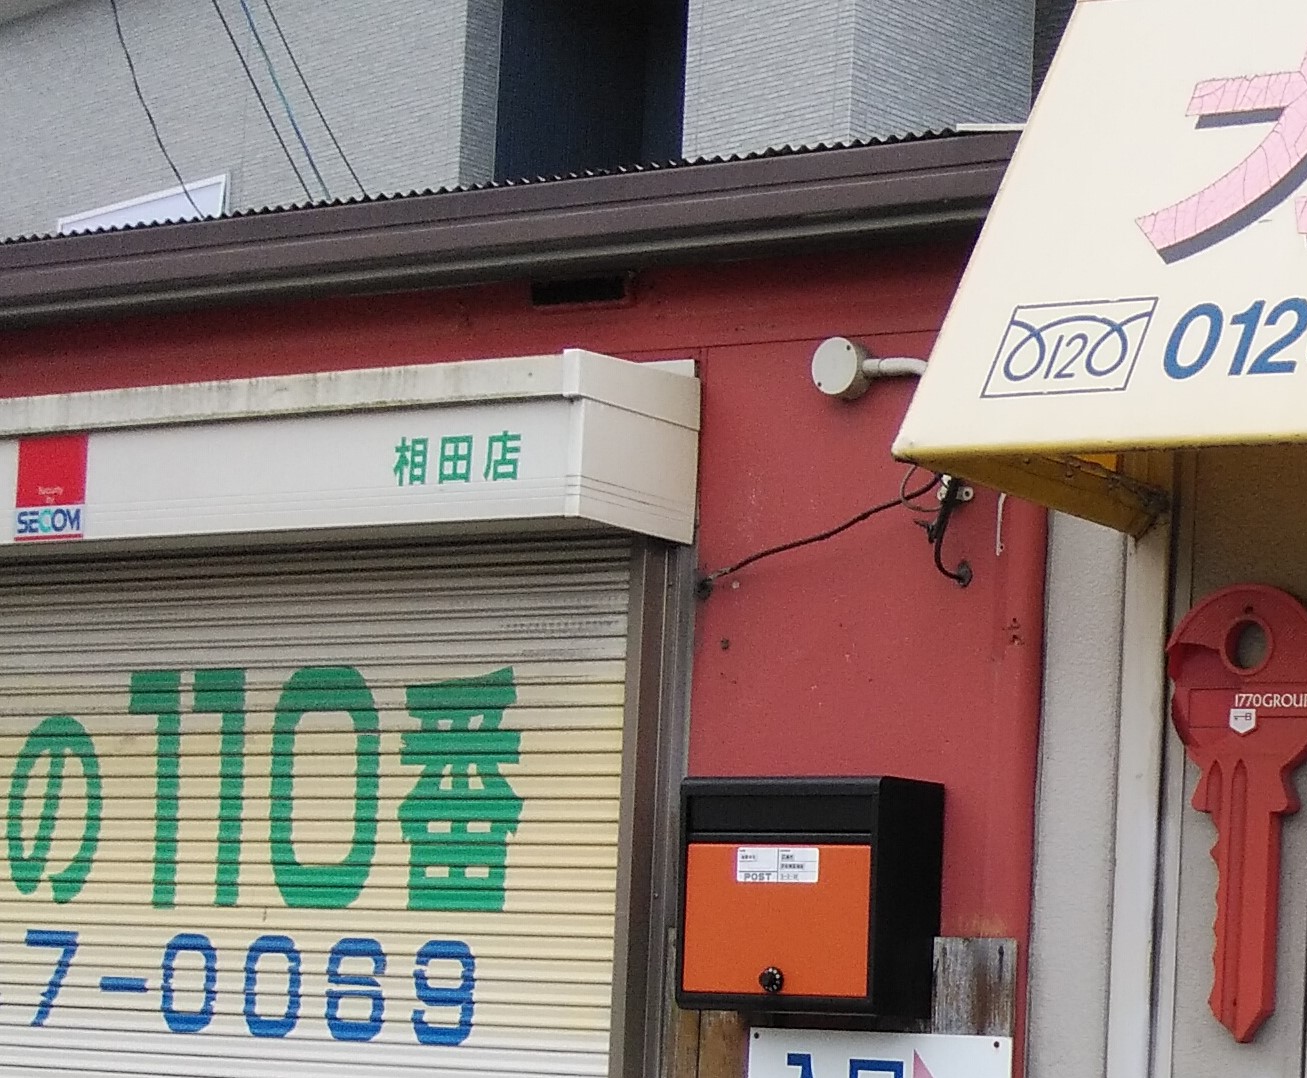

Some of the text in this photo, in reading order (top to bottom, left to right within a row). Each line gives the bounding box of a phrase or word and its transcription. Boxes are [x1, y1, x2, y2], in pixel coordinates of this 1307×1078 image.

[392, 430, 522, 486] 相田店
[17, 508, 81, 534] SECOM
[6, 666, 524, 911] の110番
[743, 872, 772, 882] POST
[25, 929, 476, 1046] 7-0069
